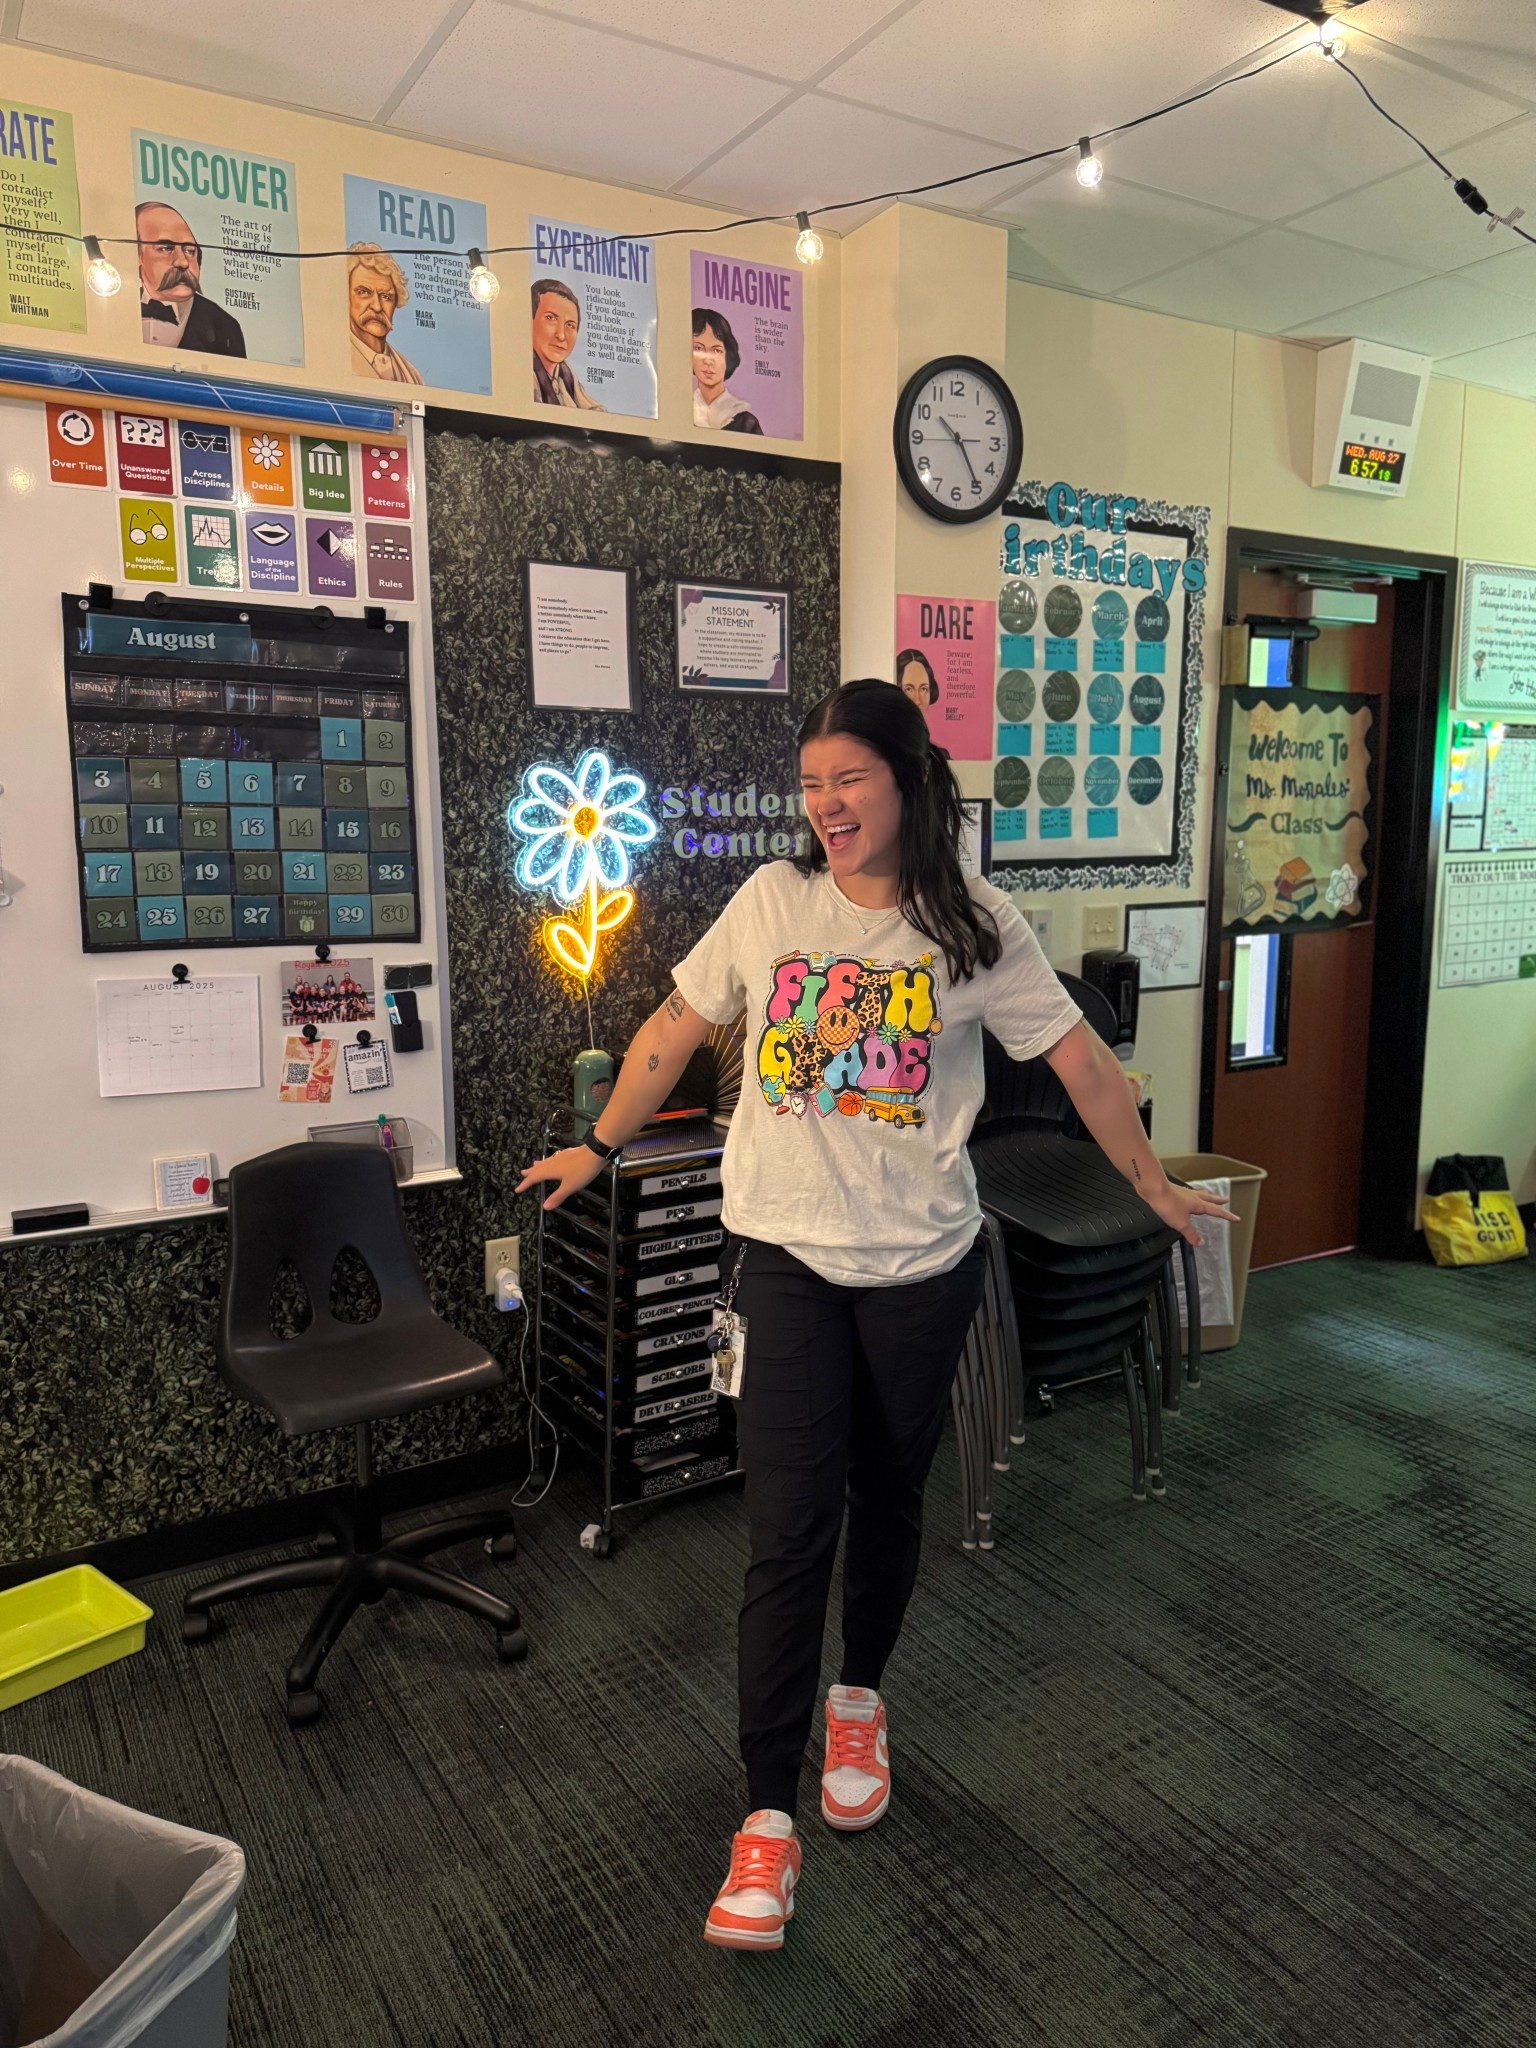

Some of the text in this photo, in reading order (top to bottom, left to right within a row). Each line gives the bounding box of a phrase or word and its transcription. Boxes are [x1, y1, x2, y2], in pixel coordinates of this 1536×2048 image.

[1, 170, 24, 182] Do I
[139, 138, 288, 213] DISCOVER
[2, 183, 53, 199] cotradict
[3, 194, 47, 208] myself?
[3, 204, 61, 224] Very well,
[379, 190, 455, 244] READ
[4, 215, 38, 229] then I
[221, 215, 272, 232] The art of
[222, 227, 271, 242] writing is
[7, 240, 49, 255] myself,
[223, 236, 270, 252] the art of
[7, 249, 69, 270] I am large,
[536, 224, 649, 284] EXPERIMENT
[8, 260, 59, 276] I contain
[224, 258, 270, 273] what you
[434, 256, 463, 268] person
[224, 267, 262, 282] believe.
[414, 262, 440, 274] won't
[443, 268, 462, 278] read
[415, 272, 425, 280] no
[9, 273, 75, 290] multitudes.
[415, 283, 451, 294] over the
[705, 260, 791, 312] IMAGINE
[225, 288, 255, 300] GUSTAVE
[586, 284, 620, 298] You look
[10, 294, 30, 305] WALT
[226, 297, 260, 310] FLAUBERT
[415, 292, 434, 301] who
[437, 294, 460, 305] can't
[586, 295, 626, 308] ridiculous
[11, 304, 49, 317] WHITMAN
[416, 310, 433, 319] MARK
[587, 303, 637, 319] if you dance.
[416, 318, 436, 329] TWAIN
[587, 312, 621, 325] You look
[754, 317, 788, 330] The brain
[587, 322, 634, 336] ridiculous if
[763, 327, 782, 337] wider
[587, 332, 601, 341] you
[604, 334, 625, 345] don't
[755, 334, 784, 346] than the
[587, 339, 639, 355] So you might
[599, 350, 615, 361] well
[617, 354, 642, 365] dance.
[755, 360, 769, 368] EMILY
[587, 367, 615, 378] GERTRUDE
[587, 375, 603, 384] STEIN
[755, 368, 781, 378] DICKINSON
[933, 386, 943, 402] 11
[951, 381, 965, 396] 12
[976, 390, 980, 406] 1
[918, 404, 930, 420] 10
[985, 410, 996, 425] 2
[989, 437, 1000, 452] 3
[1369, 450, 1386, 461] AUG
[1388, 453, 1399, 464] 27
[79, 462, 103, 472] Time
[120, 464, 170, 474] Unanswered
[985, 462, 995, 475] 4
[125, 472, 167, 482] Questions
[193, 470, 222, 479] Across
[184, 477, 230, 489] Disciplines
[252, 481, 284, 492] Details
[933, 478, 943, 492] 7
[309, 488, 344, 499] Big Idea
[951, 487, 962, 501] 6
[368, 497, 406, 508] Patterns
[1046, 482, 1137, 534] Our
[126, 562, 175, 572] Perspectives
[135, 557, 164, 565] Multiple
[250, 556, 294, 567] Language
[1004, 523, 1205, 603] irthdays
[251, 571, 296, 582] Discipline
[318, 577, 346, 586] Ethics
[379, 579, 403, 588] Rules
[712, 606, 749, 616] MISSION
[1097, 611, 1124, 620] March
[706, 617, 754, 627] STATEMENT
[921, 603, 974, 641] DARE
[1142, 616, 1162, 626] April
[127, 627, 216, 651] August
[324, 697, 353, 706] FRIDAY
[1133, 695, 1161, 705] August
[337, 730, 347, 747] 1
[1249, 731, 1348, 766] Welcome To
[94, 770, 110, 788] 3
[197, 772, 212, 789] 5
[244, 774, 258, 792] 6
[1246, 774, 1276, 799] Ms.
[661, 783, 806, 819] Studen
[338, 821, 360, 838] 15
[1271, 812, 1322, 835] Class
[673, 827, 811, 858] Center
[97, 864, 122, 882] 17
[195, 864, 219, 881] 19
[293, 863, 316, 880] 21
[378, 865, 405, 881] 23
[1452, 873, 1481, 884] TICKET
[1483, 873, 1500, 882] OUT
[147, 908, 177, 926] 25
[243, 907, 270, 924] 27
[337, 907, 363, 923] 29
[768, 961, 933, 1032] FIFTH
[759, 1027, 929, 1092] GRADE
[661, 1173, 707, 1189] PENCILS
[1477, 1230, 1495, 1242] GO
[641, 1233, 721, 1255] HIGHLIGHTERS
[653, 1330, 705, 1348] CRAYONS
[639, 1406, 662, 1418] DRY
